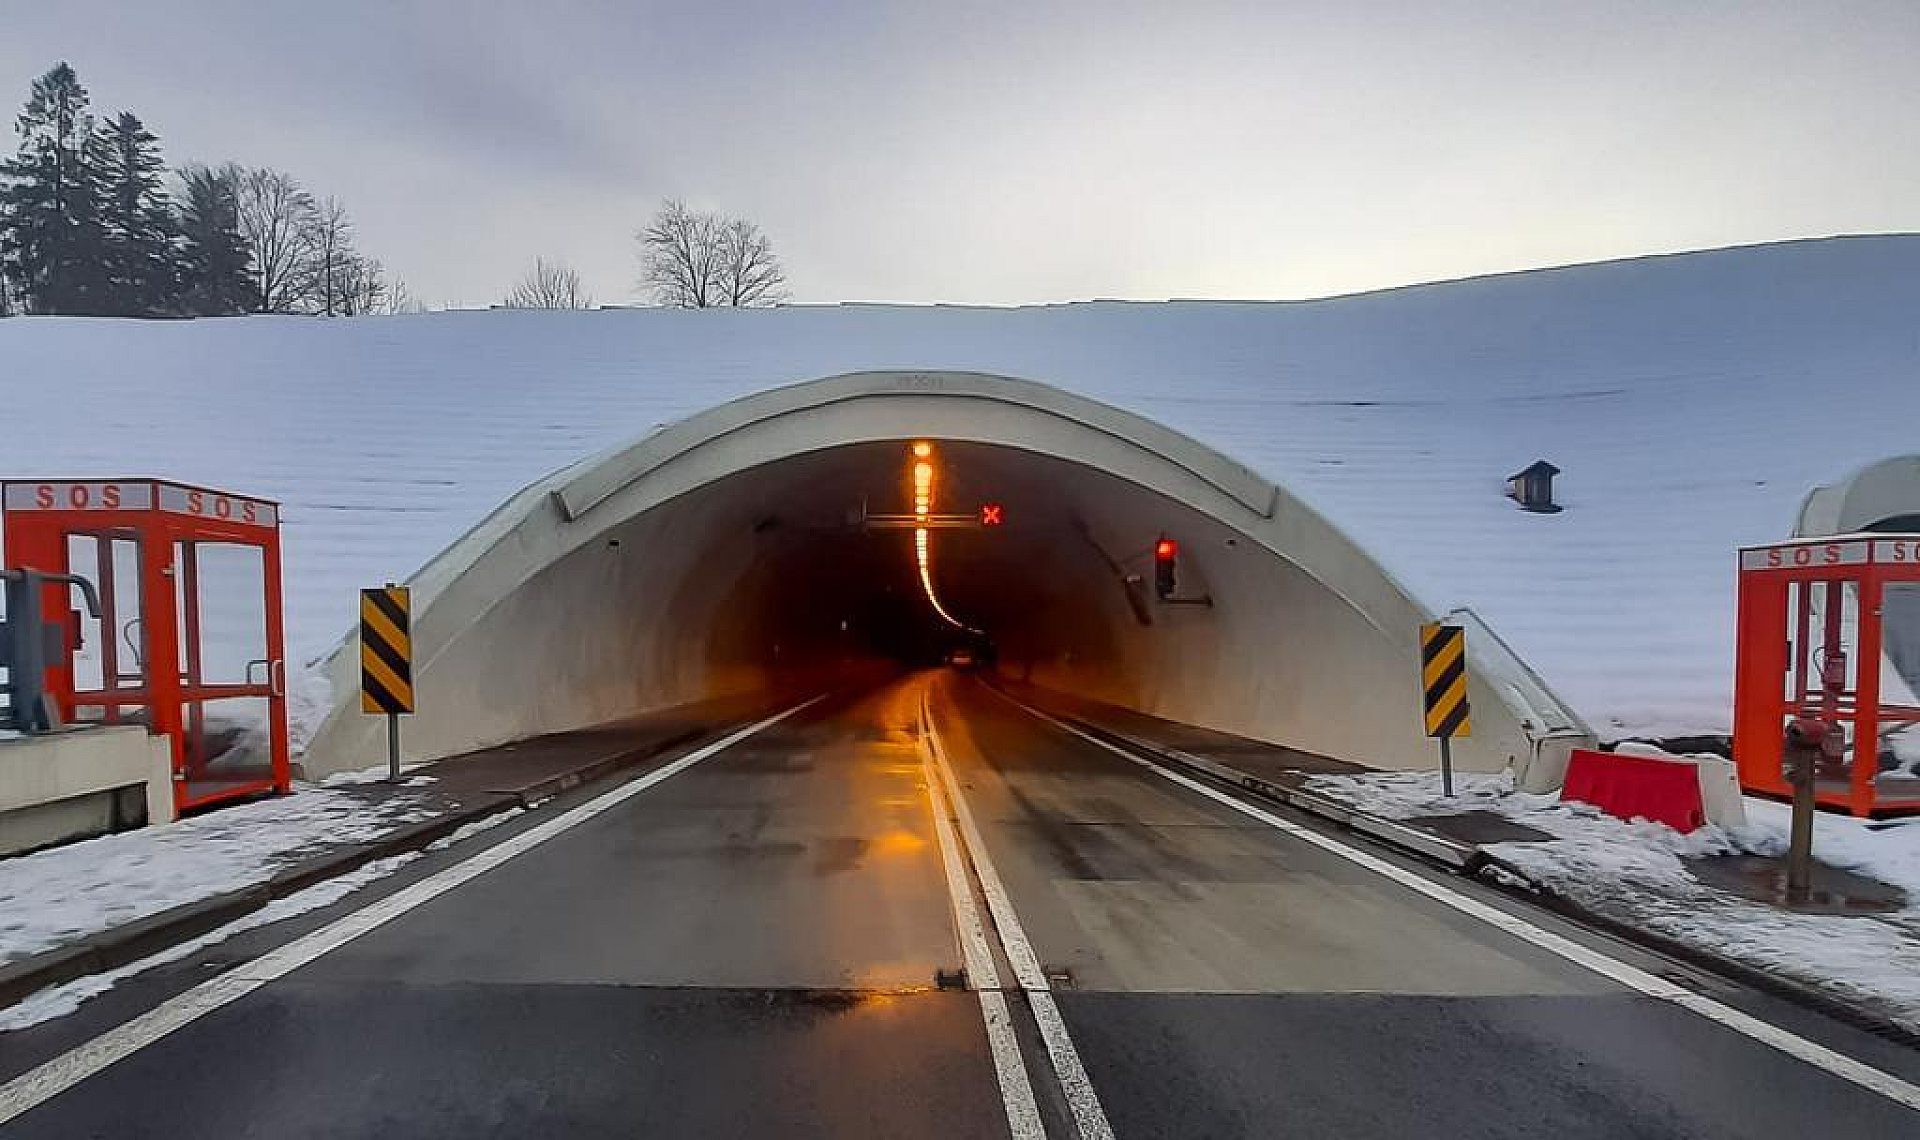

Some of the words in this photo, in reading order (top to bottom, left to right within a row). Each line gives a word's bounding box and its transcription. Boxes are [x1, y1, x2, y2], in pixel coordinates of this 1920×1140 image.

[37, 484, 120, 509] SOS
[188, 489, 256, 522] SOS
[1768, 545, 1840, 567] SOS
